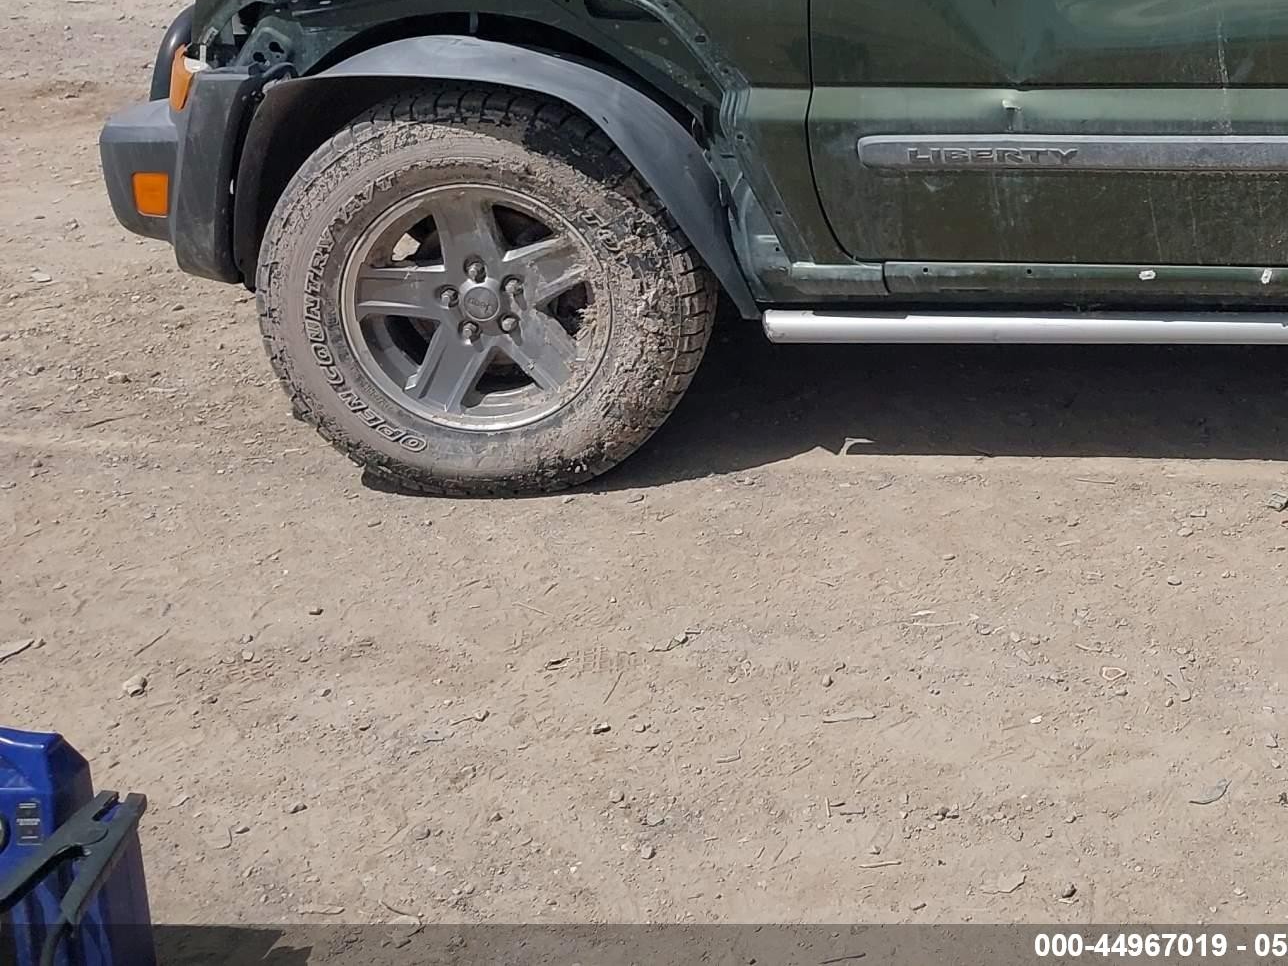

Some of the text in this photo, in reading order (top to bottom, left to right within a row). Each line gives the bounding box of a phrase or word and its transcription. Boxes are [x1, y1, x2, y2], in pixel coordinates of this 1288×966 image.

[906, 147, 1079, 165] LIBERTY
[304, 223, 346, 387] COUNTRY
[338, 389, 427, 453] OPEN
